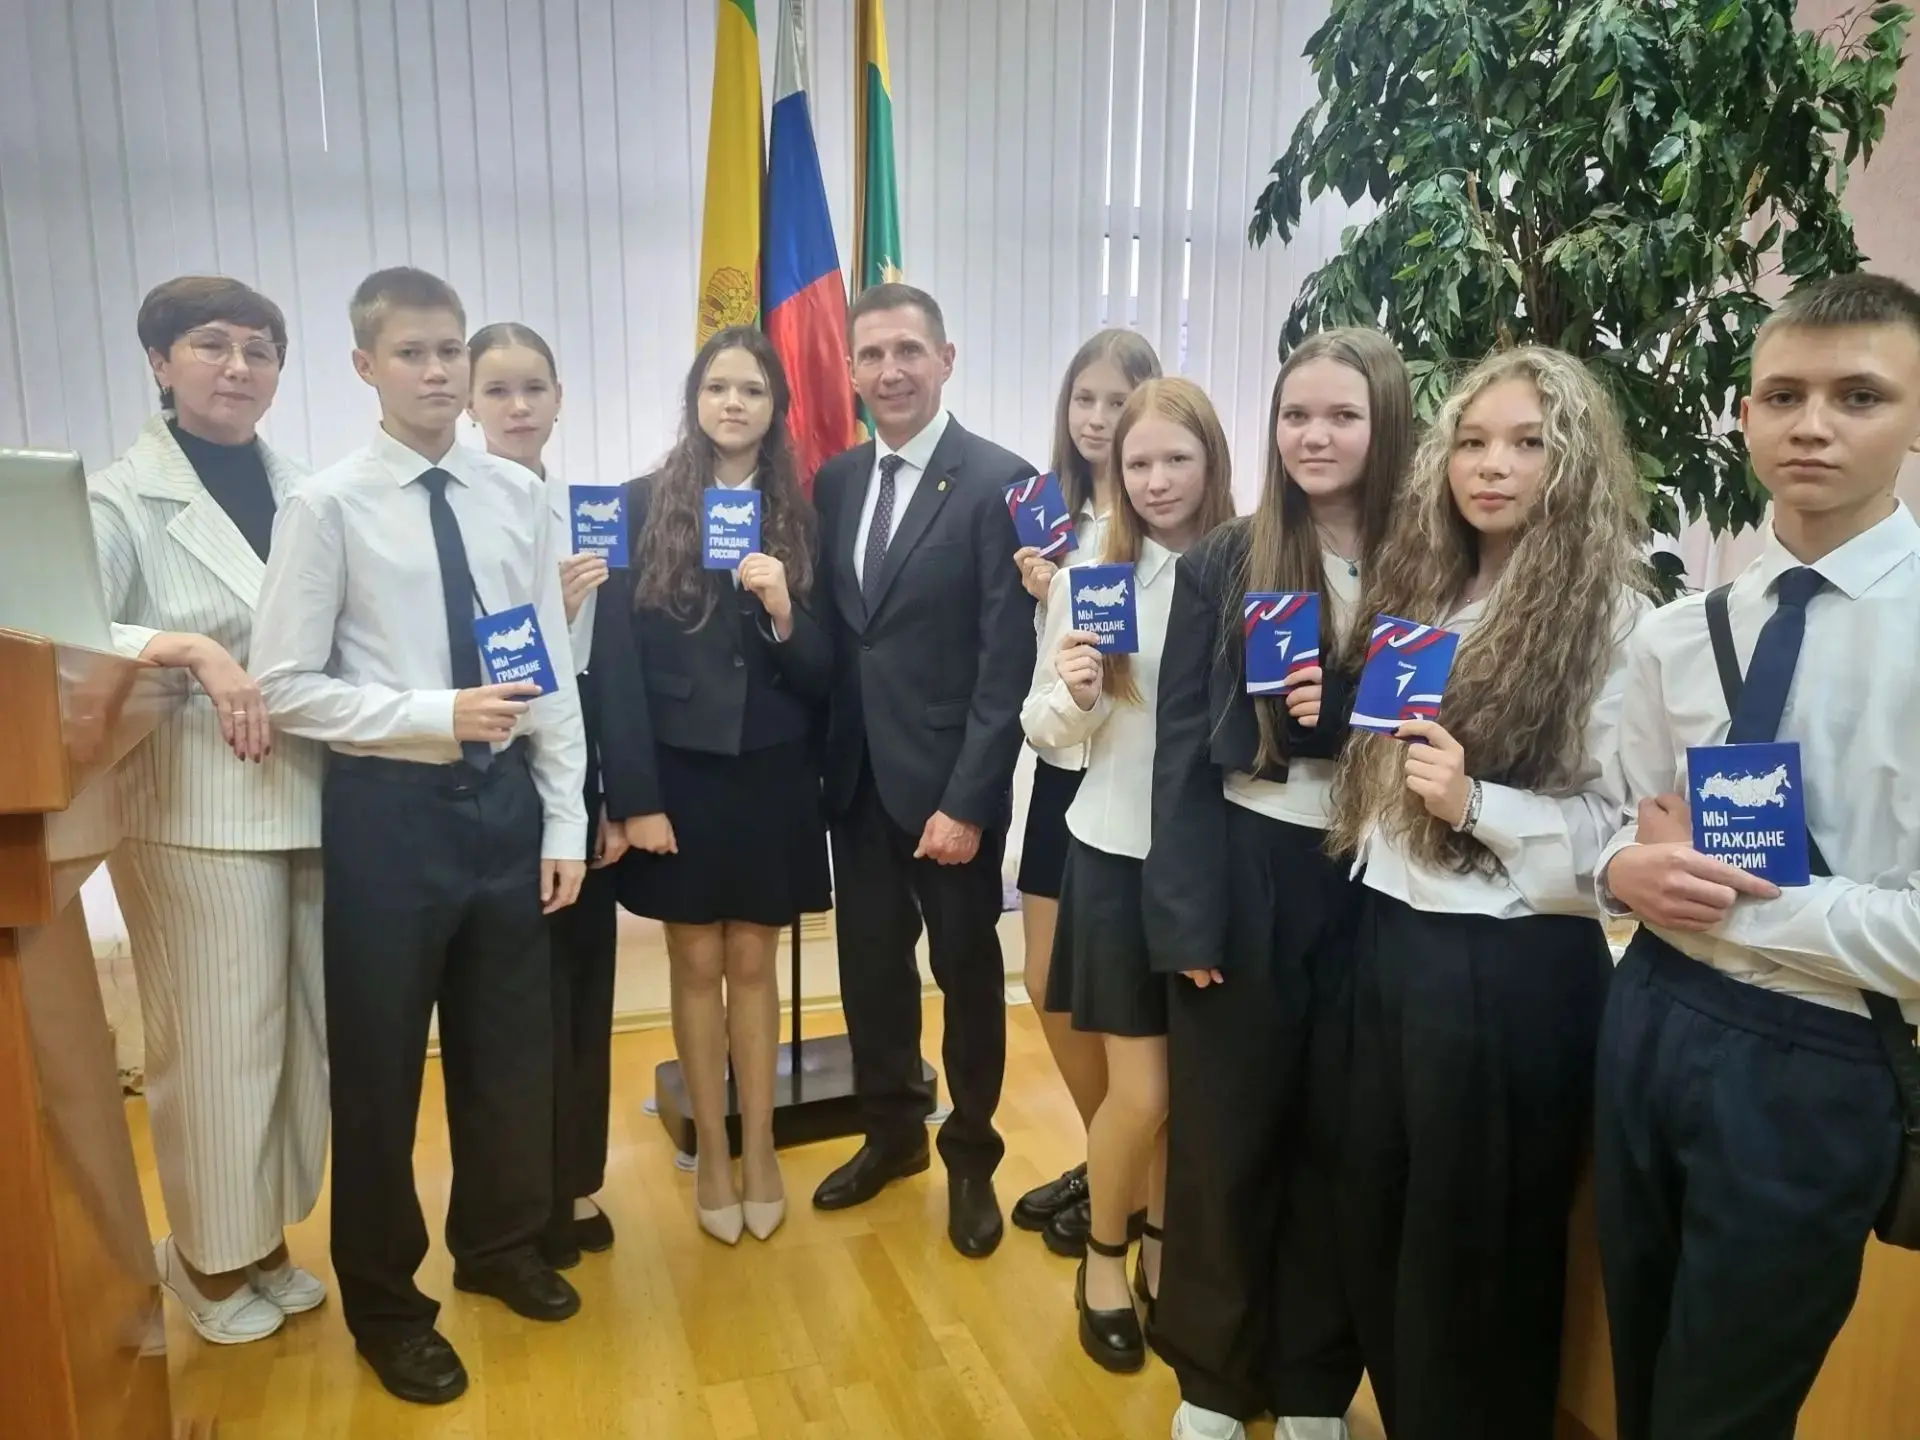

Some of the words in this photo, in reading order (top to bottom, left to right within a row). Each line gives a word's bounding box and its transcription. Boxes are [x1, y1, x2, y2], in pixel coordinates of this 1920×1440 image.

[1077, 609, 1094, 621] МЫ
[1078, 619, 1126, 633] ГРАЖДАНЕ
[491, 655, 510, 670] МЫ
[495, 659, 542, 684] ГРАЖДАНЕ
[1702, 810, 1729, 827] МЫ
[1703, 830, 1786, 850] ГРАЖДАНЕ
[1704, 852, 1767, 869] ОССИИ!
